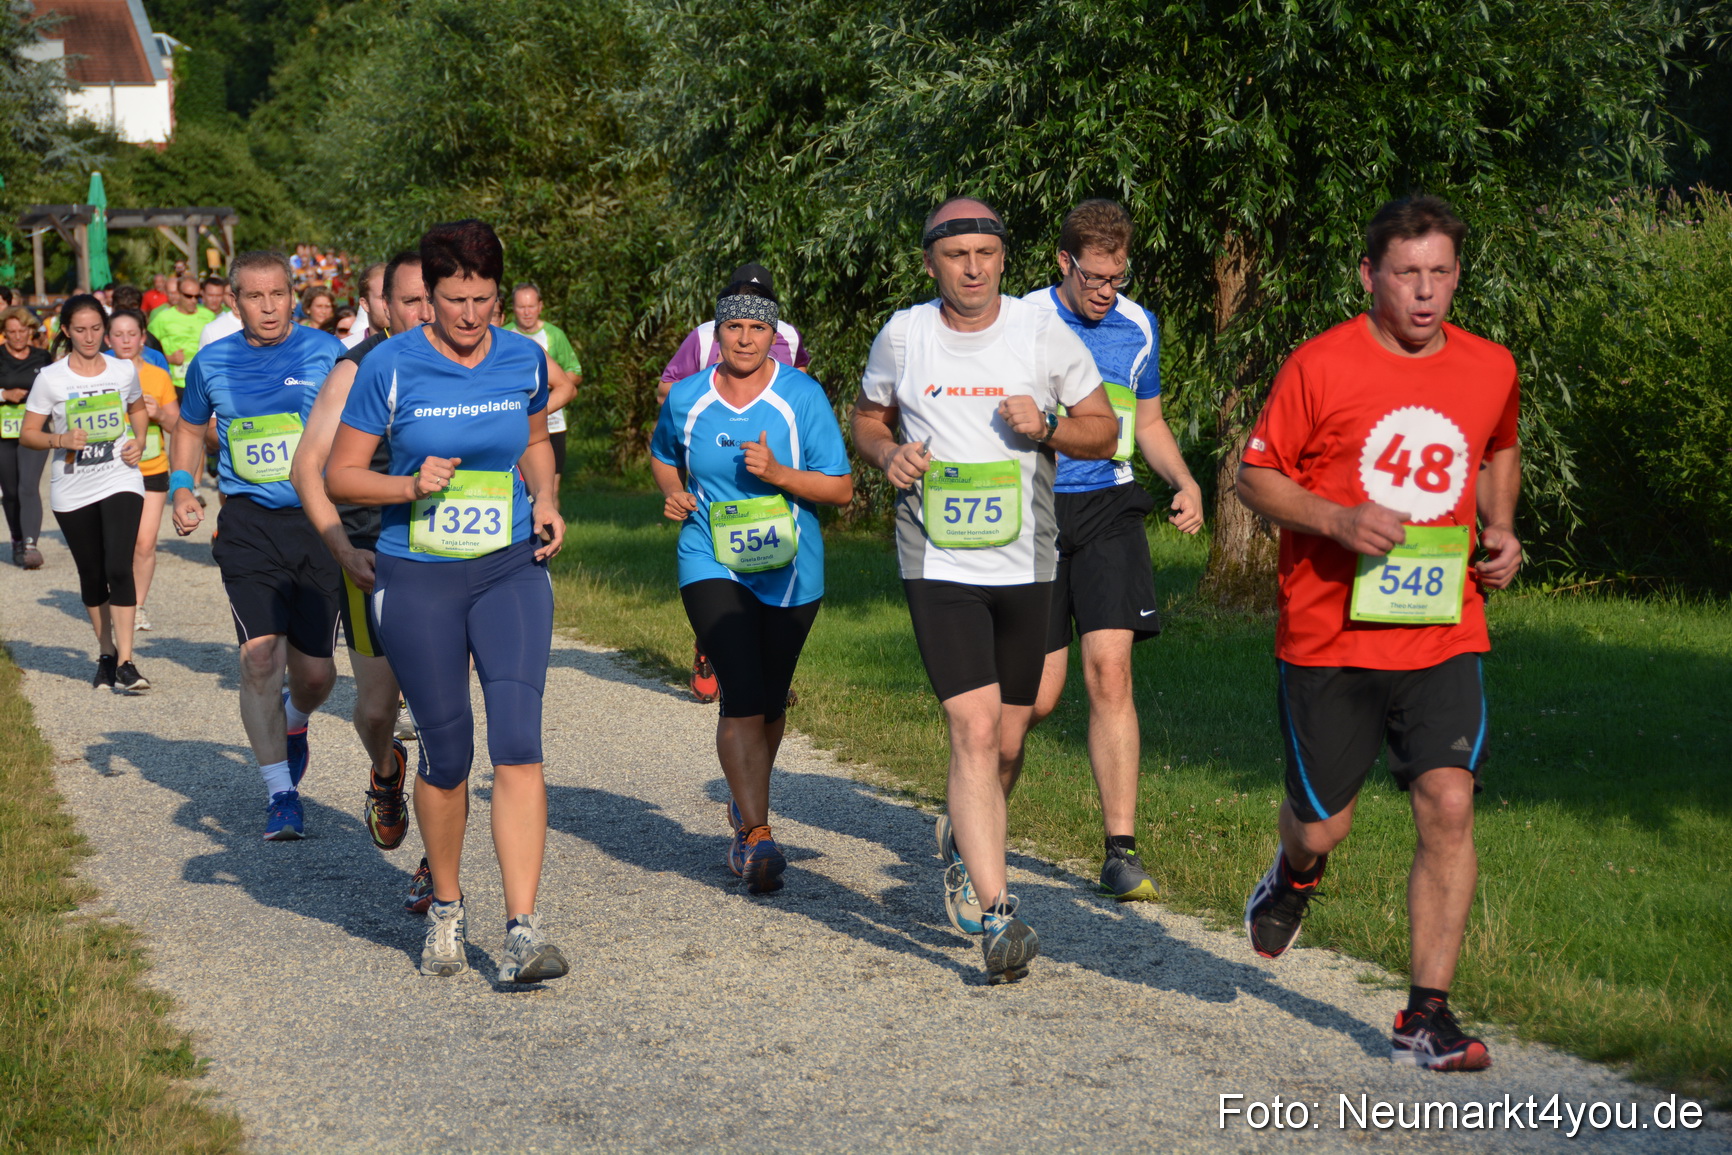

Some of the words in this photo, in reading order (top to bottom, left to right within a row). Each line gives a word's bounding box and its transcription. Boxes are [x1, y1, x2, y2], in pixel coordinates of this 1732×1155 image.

[946, 386, 1009, 397] KLEBL
[74, 412, 119, 430] 1155
[414, 399, 521, 418] energiegeladen
[246, 440, 289, 465] 561
[1373, 433, 1455, 493] 48
[423, 505, 501, 535] 1323
[943, 496, 1003, 524] 575
[730, 525, 780, 554] 554
[1379, 565, 1444, 596] 548
